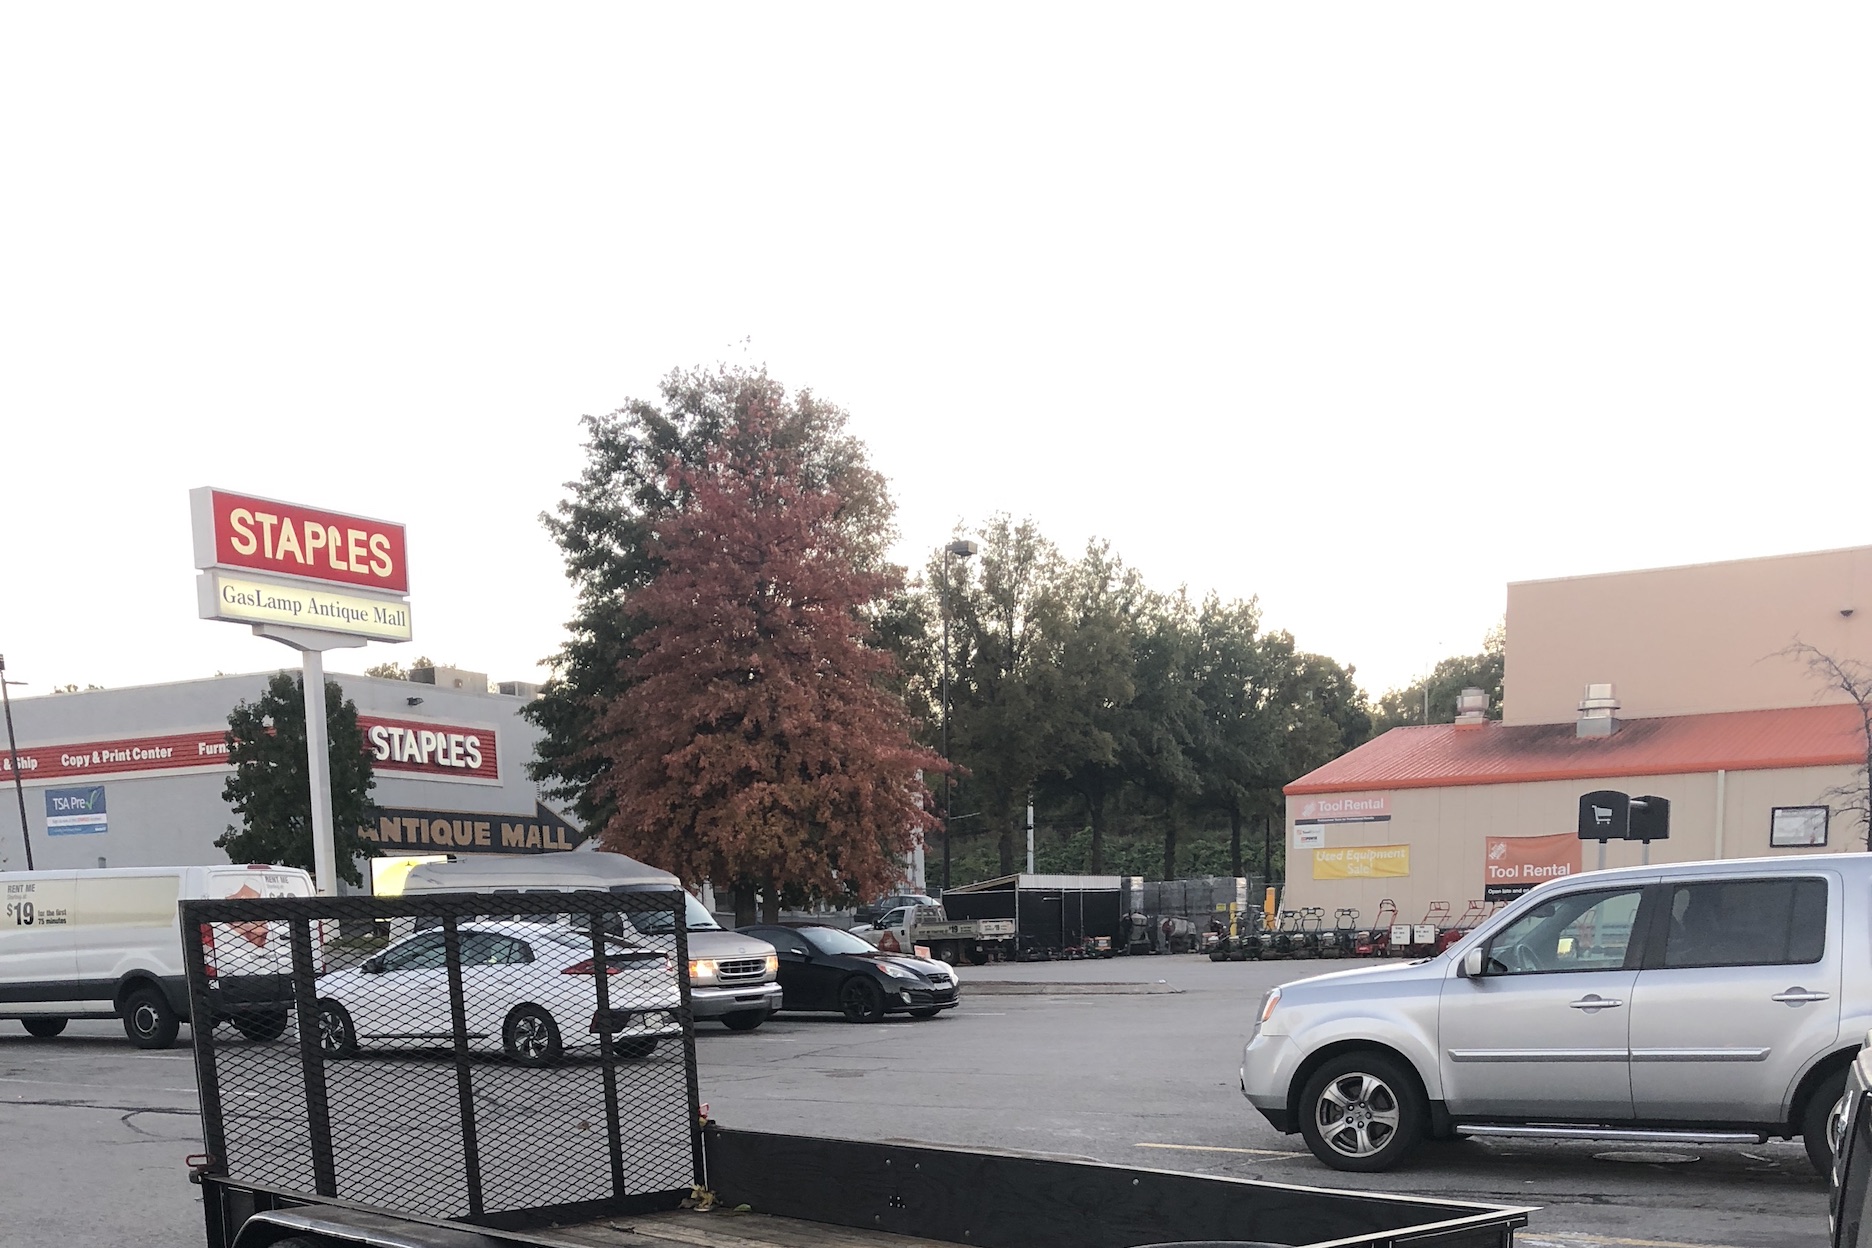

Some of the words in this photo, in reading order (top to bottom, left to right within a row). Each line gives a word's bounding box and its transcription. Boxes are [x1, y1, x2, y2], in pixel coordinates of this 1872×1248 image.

[230, 508, 393, 577] STAPLES
[222, 585, 302, 616] GasLamp
[308, 598, 369, 623] Antique
[373, 606, 407, 627] Mall
[368, 725, 482, 769] STAPLES
[3, 758, 12, 771] &
[61, 753, 89, 768] Copy
[92, 749, 101, 764] &
[102, 748, 131, 763] Print
[133, 746, 173, 760] Center
[53, 797, 70, 810] TSA
[71, 797, 86, 809] Pre
[1318, 800, 1343, 812] Tool
[1344, 797, 1384, 811] Rental
[358, 816, 491, 847] ANTIQUE
[501, 823, 573, 850] MALL
[1316, 850, 1343, 862] Used
[1346, 848, 1406, 863] Equipment
[1488, 864, 1519, 878] Tool
[1523, 862, 1571, 877] Rental
[7, 884, 24, 893] RENT
[25, 884, 35, 892] ME
[6, 901, 34, 926] $19
